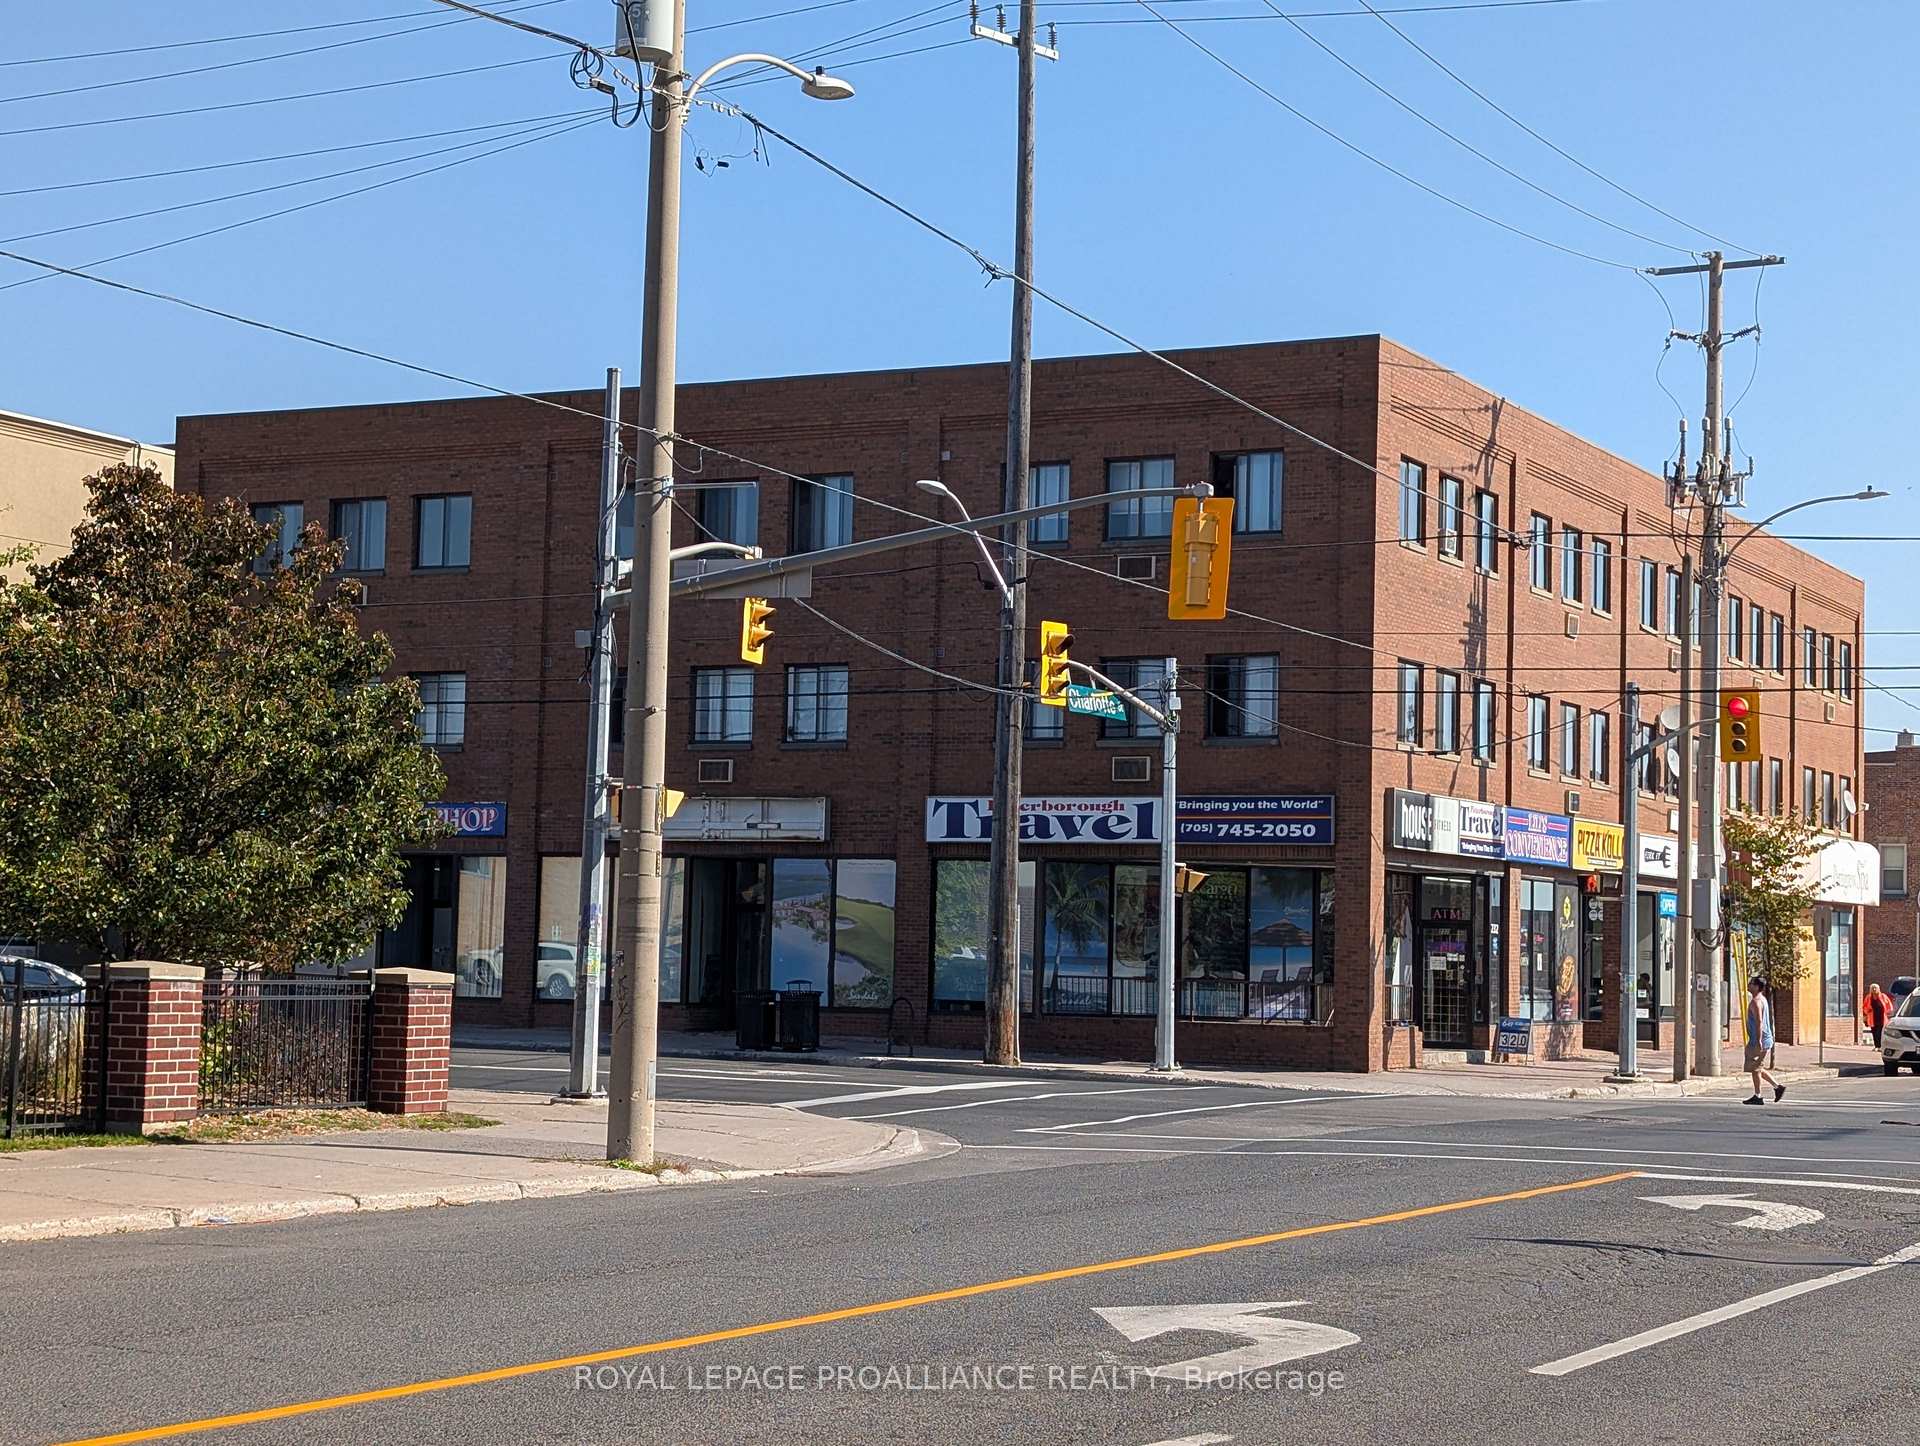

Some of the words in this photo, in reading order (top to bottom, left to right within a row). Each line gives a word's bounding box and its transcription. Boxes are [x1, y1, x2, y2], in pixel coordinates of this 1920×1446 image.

[1232, 801, 1255, 811] you
[1257, 800, 1278, 809] the
[1181, 823, 1213, 834] (705)
[1217, 823, 1316, 838] 745-2050
[1460, 805, 1504, 837] Travel
[1505, 829, 1568, 863] CONVENIENCE
[1577, 829, 1600, 857] PIZZA
